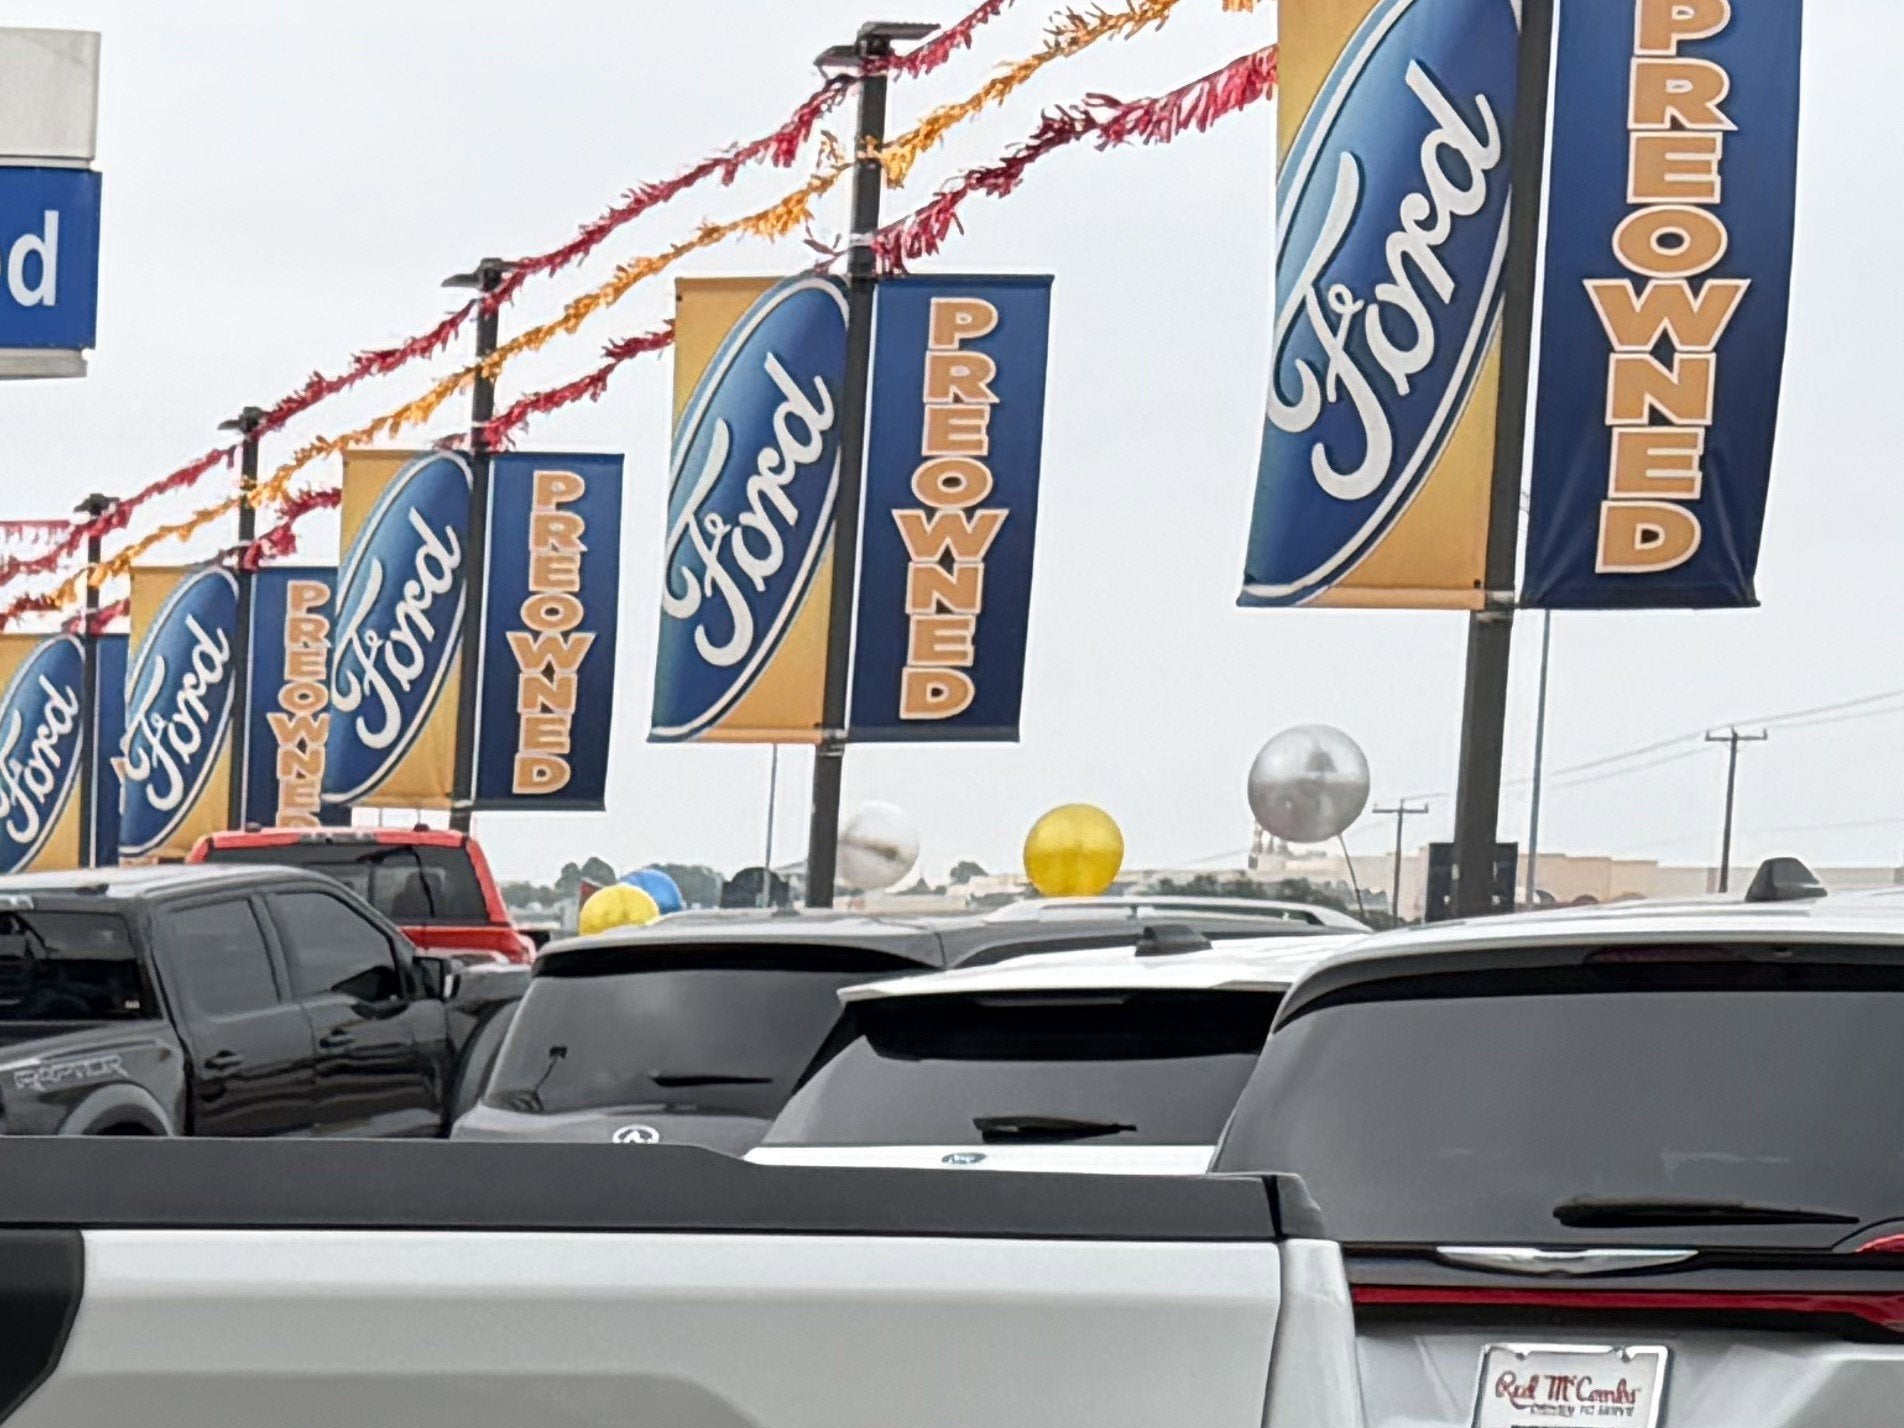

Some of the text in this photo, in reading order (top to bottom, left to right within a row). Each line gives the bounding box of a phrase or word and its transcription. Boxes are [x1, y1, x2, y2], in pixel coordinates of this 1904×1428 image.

[1266, 60, 1504, 499] Ford
[331, 507, 461, 748] Ford
[505, 470, 596, 794] PREOWNED
[662, 352, 834, 666] Ford
[892, 297, 1009, 720] PREOWNED
[120, 614, 229, 810] Ford
[14, 1054, 129, 1092] RAPTOR
[1495, 1371, 1539, 1409] Red
